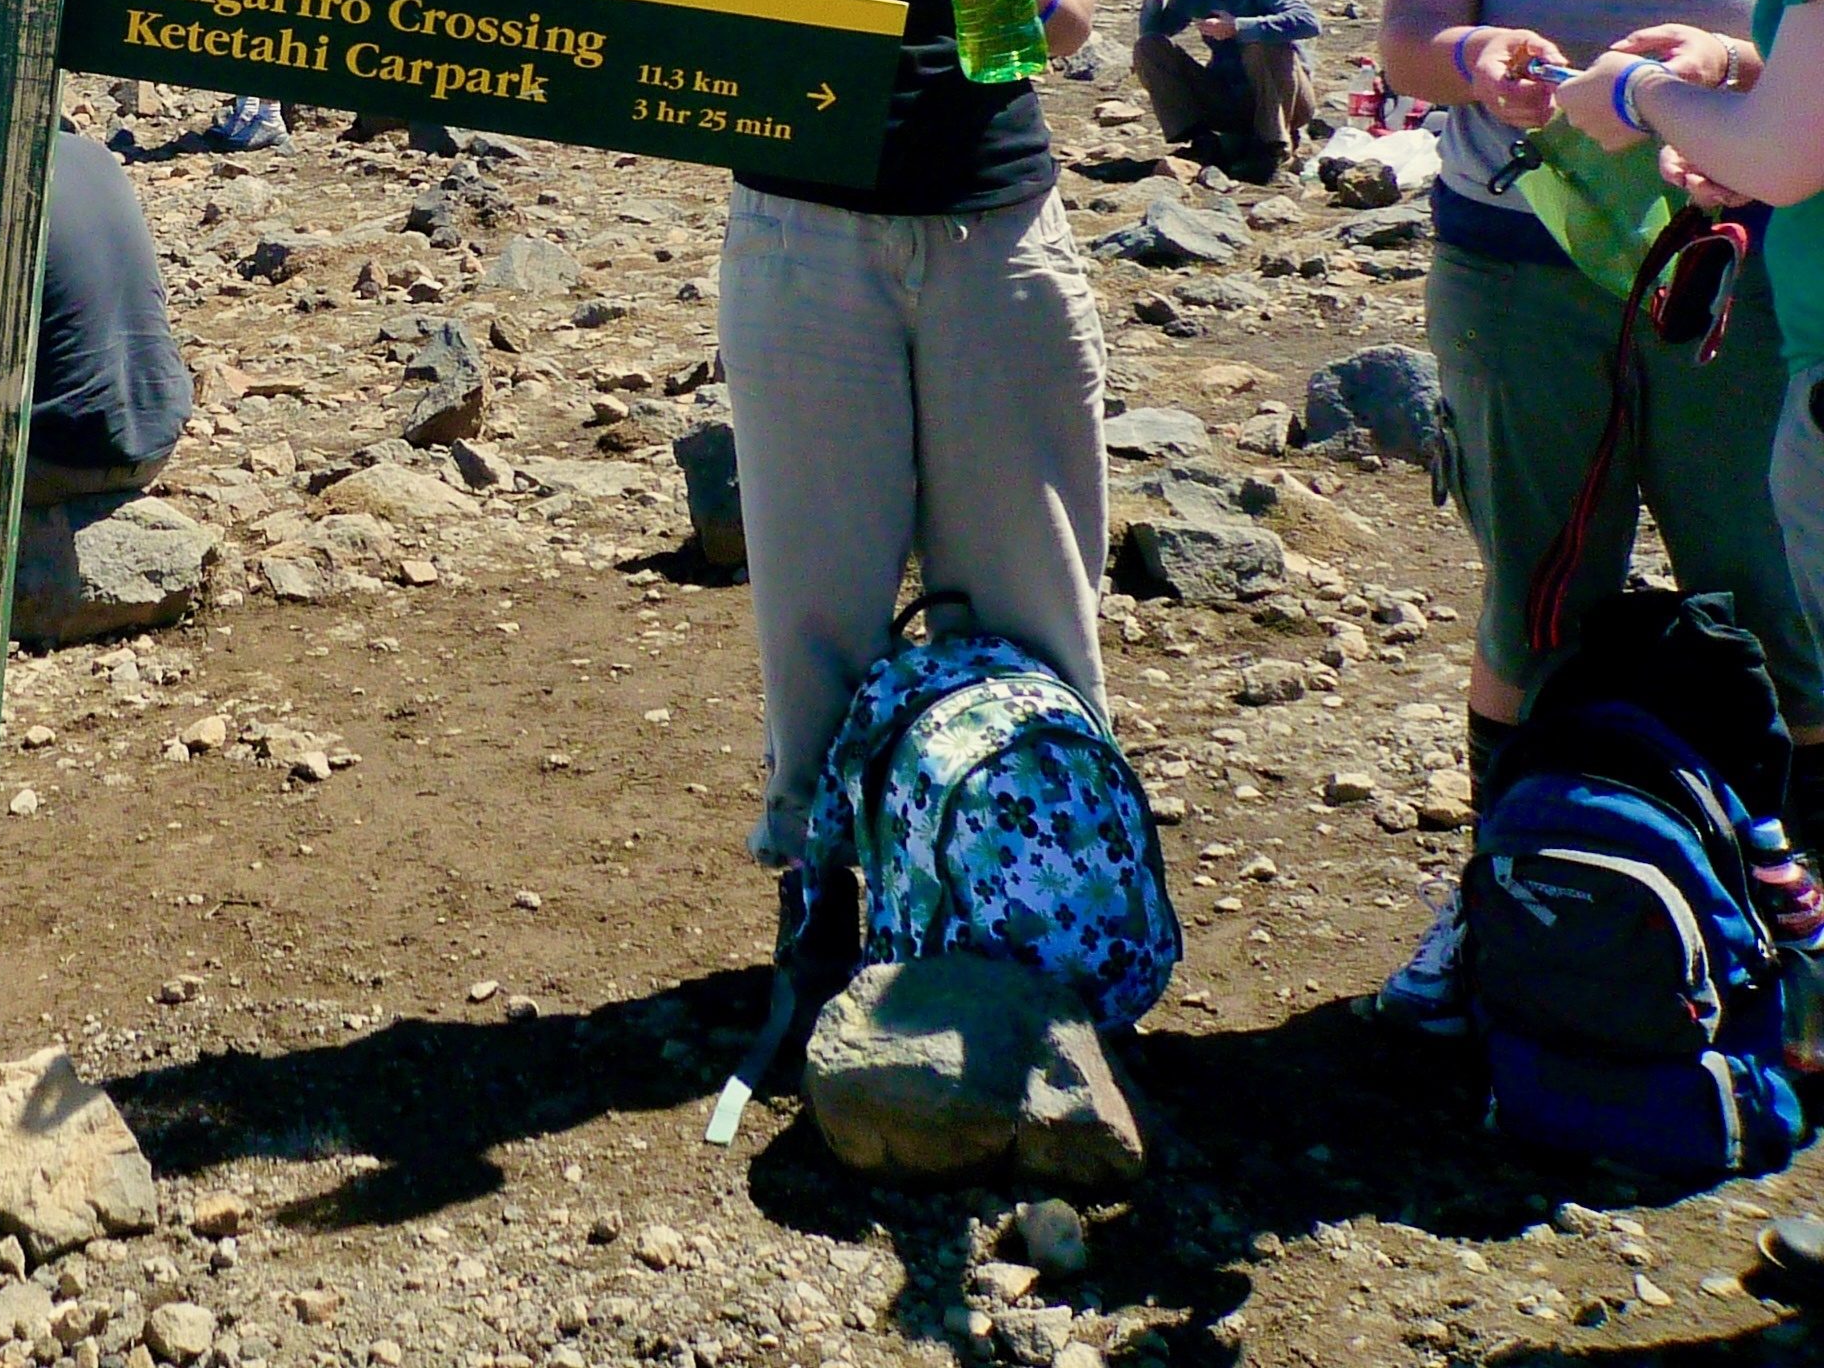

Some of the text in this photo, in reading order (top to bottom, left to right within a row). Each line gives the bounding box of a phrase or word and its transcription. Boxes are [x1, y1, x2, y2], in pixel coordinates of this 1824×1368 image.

[123, 9, 549, 103] Ketetahi Carpark
[637, 64, 739, 97] 11.3 km
[632, 98, 792, 140] 3 hr 25 min
